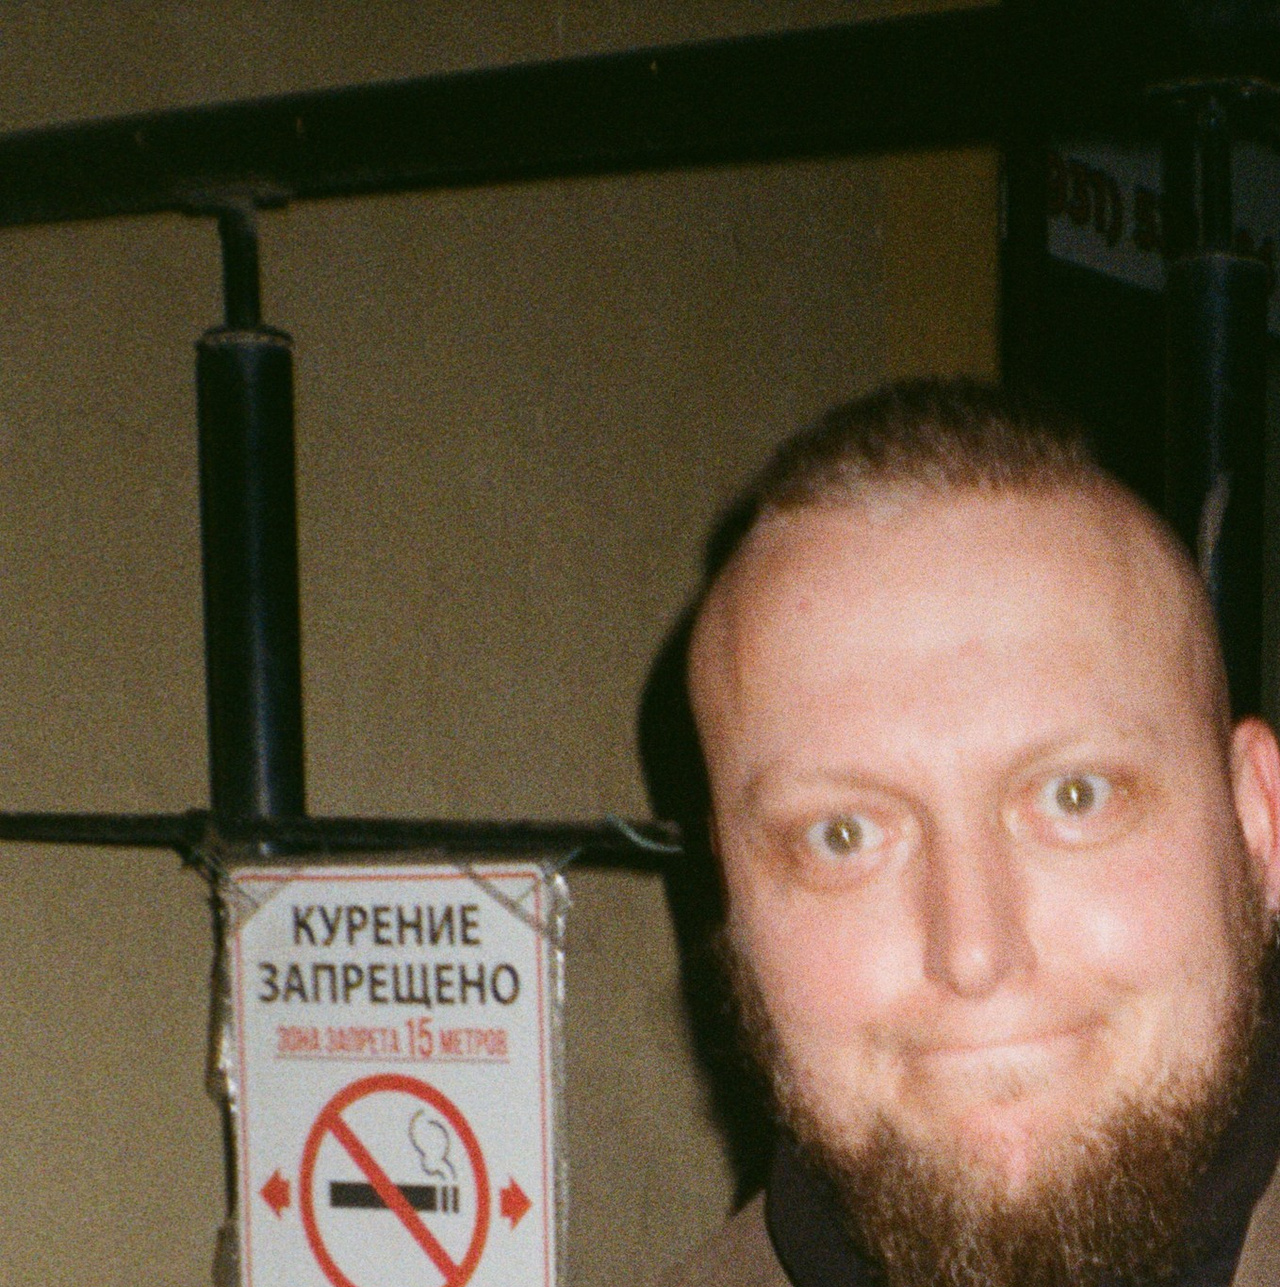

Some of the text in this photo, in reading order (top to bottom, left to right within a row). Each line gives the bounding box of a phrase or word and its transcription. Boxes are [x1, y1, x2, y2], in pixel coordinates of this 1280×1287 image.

[292, 904, 482, 946] КУРЕНИЕ
[258, 962, 521, 1009] ЗАПРЕЩЕНО
[277, 1016, 508, 1058] ЗОНА ЗАПРЕТА 15 МЕТРОВ
